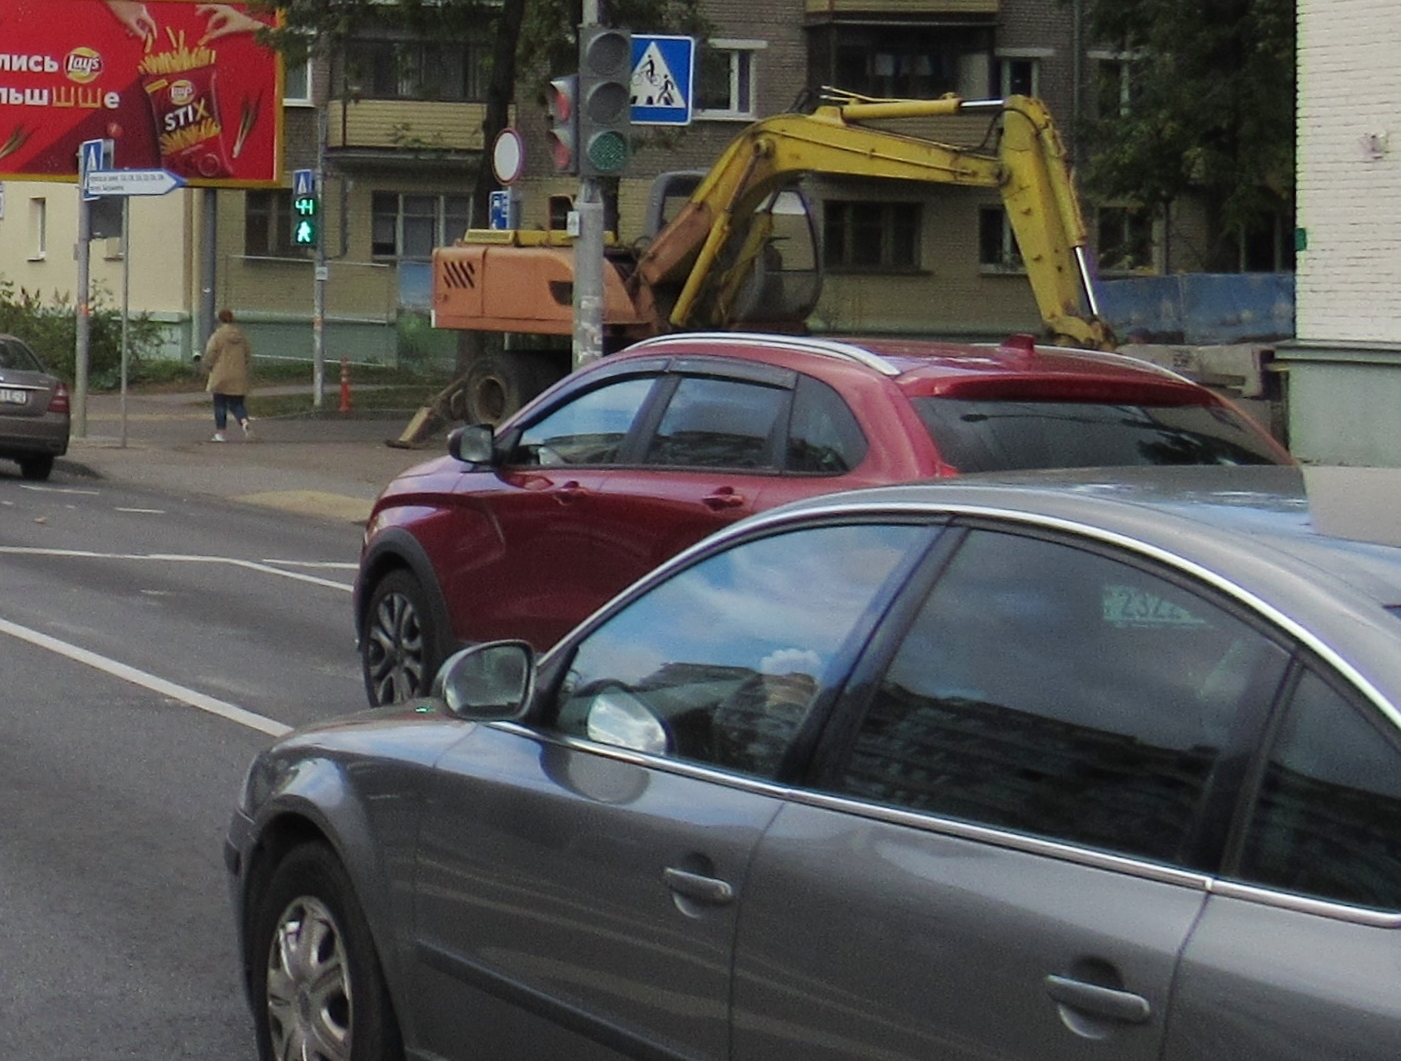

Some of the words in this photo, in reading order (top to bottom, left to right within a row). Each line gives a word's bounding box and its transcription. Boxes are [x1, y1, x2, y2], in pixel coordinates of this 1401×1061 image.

[67, 54, 101, 76] Lay's
[164, 98, 210, 131] STIX
[295, 199, 314, 215] 44
